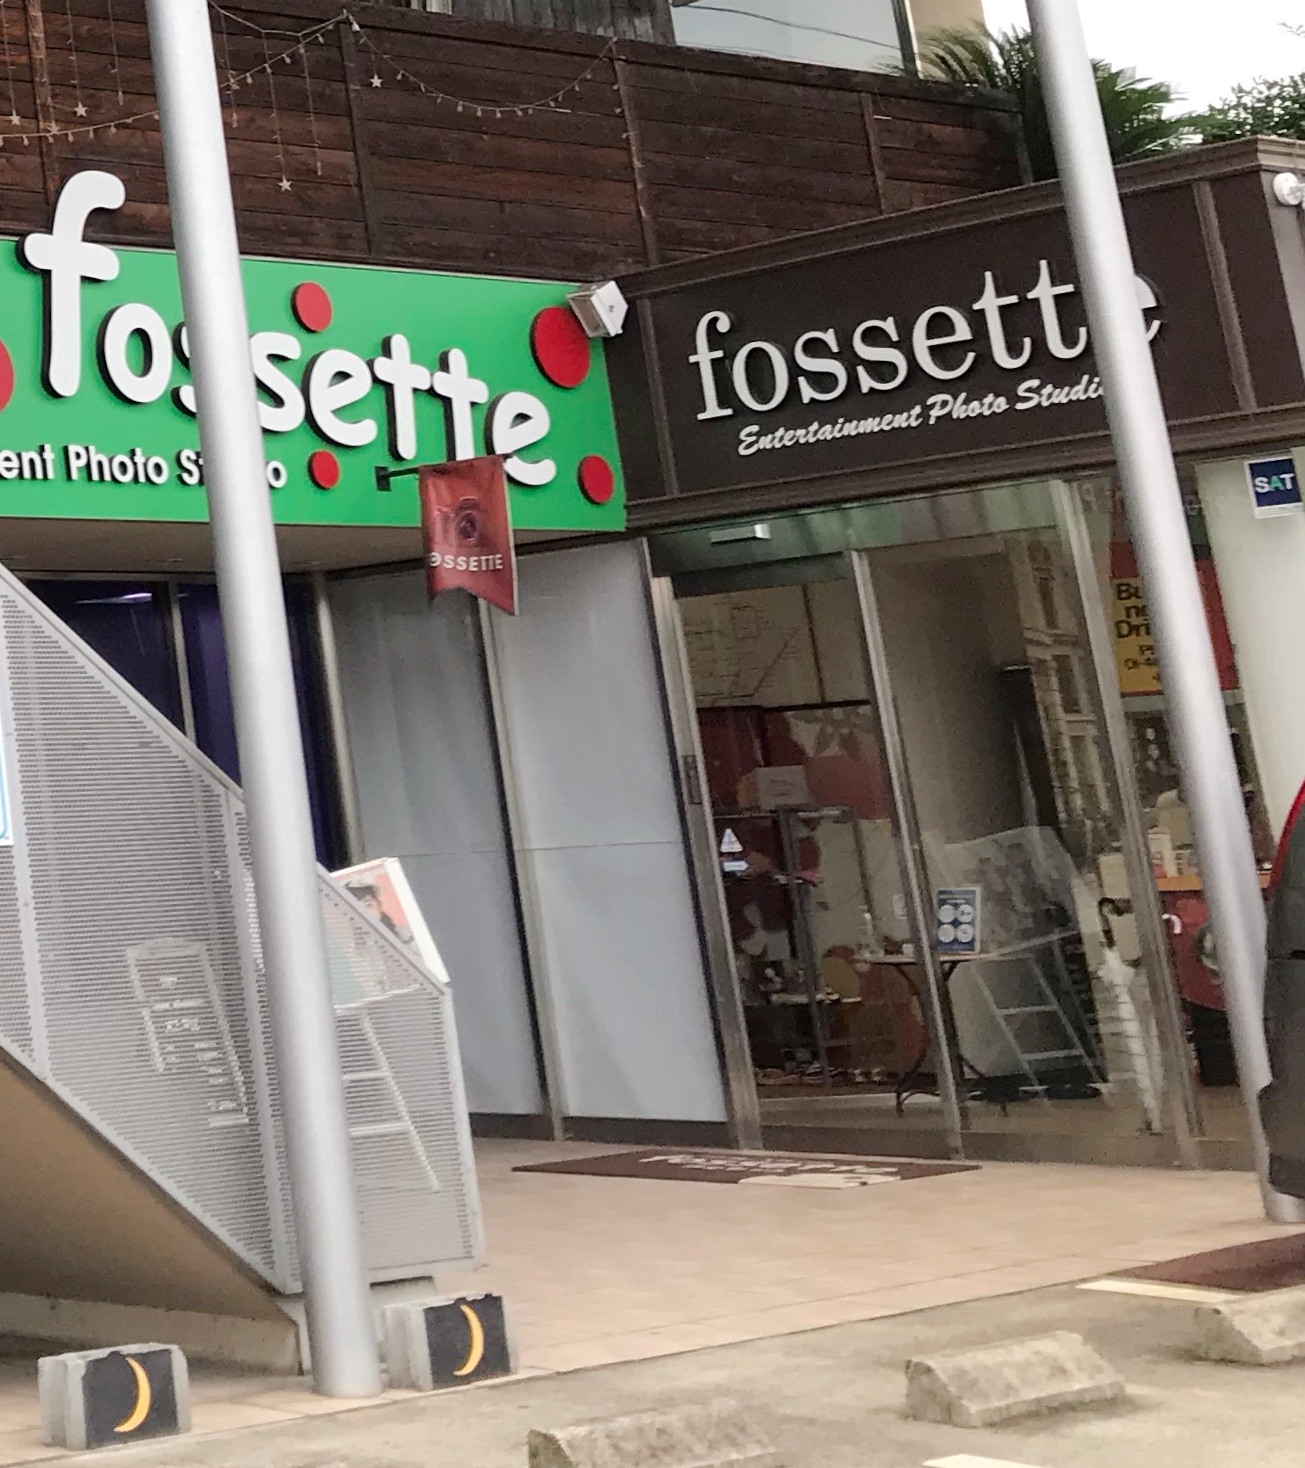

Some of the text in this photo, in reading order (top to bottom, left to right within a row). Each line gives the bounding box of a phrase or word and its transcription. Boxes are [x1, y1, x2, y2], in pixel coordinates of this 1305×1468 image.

[20, 169, 557, 487] fosette
[737, 373, 1106, 457] Entertainment Photo Studi
[65, 443, 170, 485] Photo
[1254, 473, 1295, 494] SAT
[428, 551, 504, 572] OSSETTE
